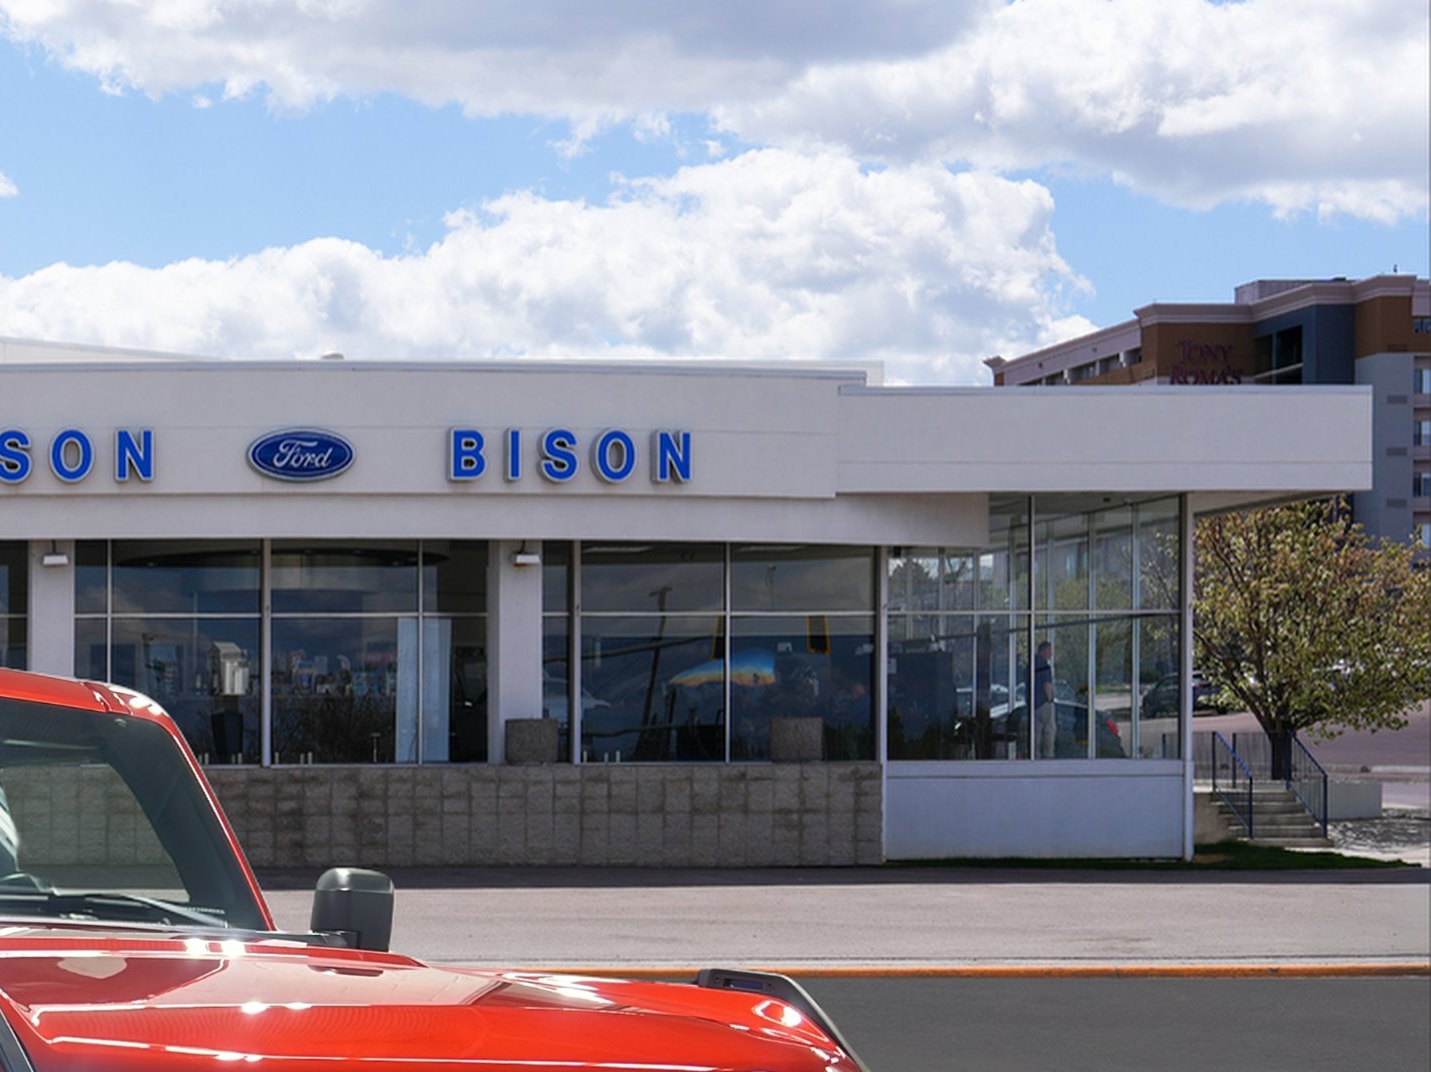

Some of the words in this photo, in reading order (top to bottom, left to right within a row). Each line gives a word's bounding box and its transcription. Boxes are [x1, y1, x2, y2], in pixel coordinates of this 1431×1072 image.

[1177, 339, 1233, 362] TONY
[272, 439, 334, 470] Ford
[446, 427, 692, 484] BISON
